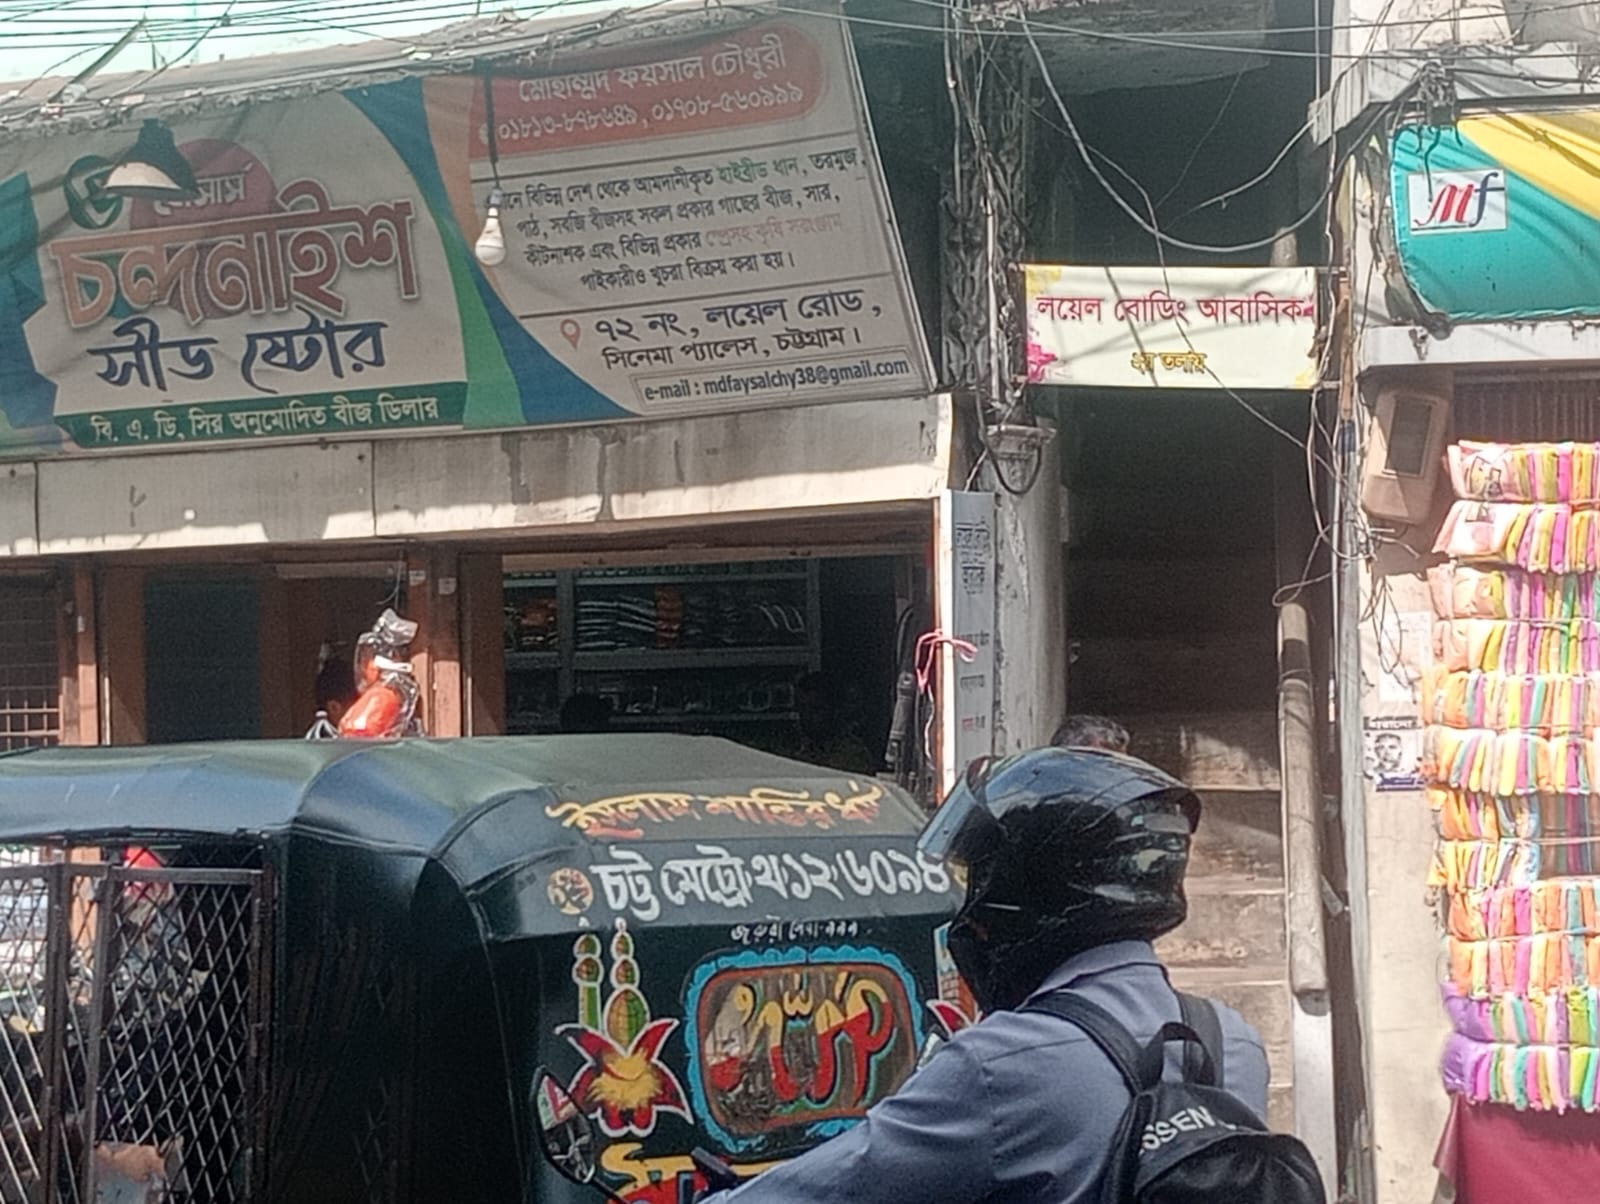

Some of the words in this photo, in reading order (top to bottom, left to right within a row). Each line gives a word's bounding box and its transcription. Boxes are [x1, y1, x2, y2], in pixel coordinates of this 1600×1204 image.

[614, 55, 705, 89] ফয়সাল
[711, 32, 787, 80] চৌধুরী
[525, 182, 564, 208] বিভিন্ন
[566, 182, 594, 204] দেশ
[597, 178, 631, 200] থেকে
[638, 203, 674, 224] সকল
[676, 199, 715, 220] প্রকার
[718, 193, 761, 214] গাছের
[48, 176, 421, 328] চন্দনাইশ
[590, 241, 619, 262] এবং
[619, 232, 661, 258] বিভিন্ন
[663, 231, 702, 252] প্রকার
[649, 263, 684, 288] খুচরা
[728, 253, 760, 273] করা
[595, 317, 641, 343] ৭২
[702, 297, 789, 329] লয়েল
[1036, 295, 1105, 324] লয়েল
[1195, 289, 1306, 326] আবাসিক
[87, 316, 218, 392] সীড
[601, 345, 675, 371] সিনেমা
[643, 378, 691, 401] e-mail
[703, 357, 910, 397] mdfaysalchy38@gmail.com
[228, 400, 327, 436] অনুমোদিত
[331, 394, 373, 425] বীজ
[377, 391, 439, 423] ডিলার
